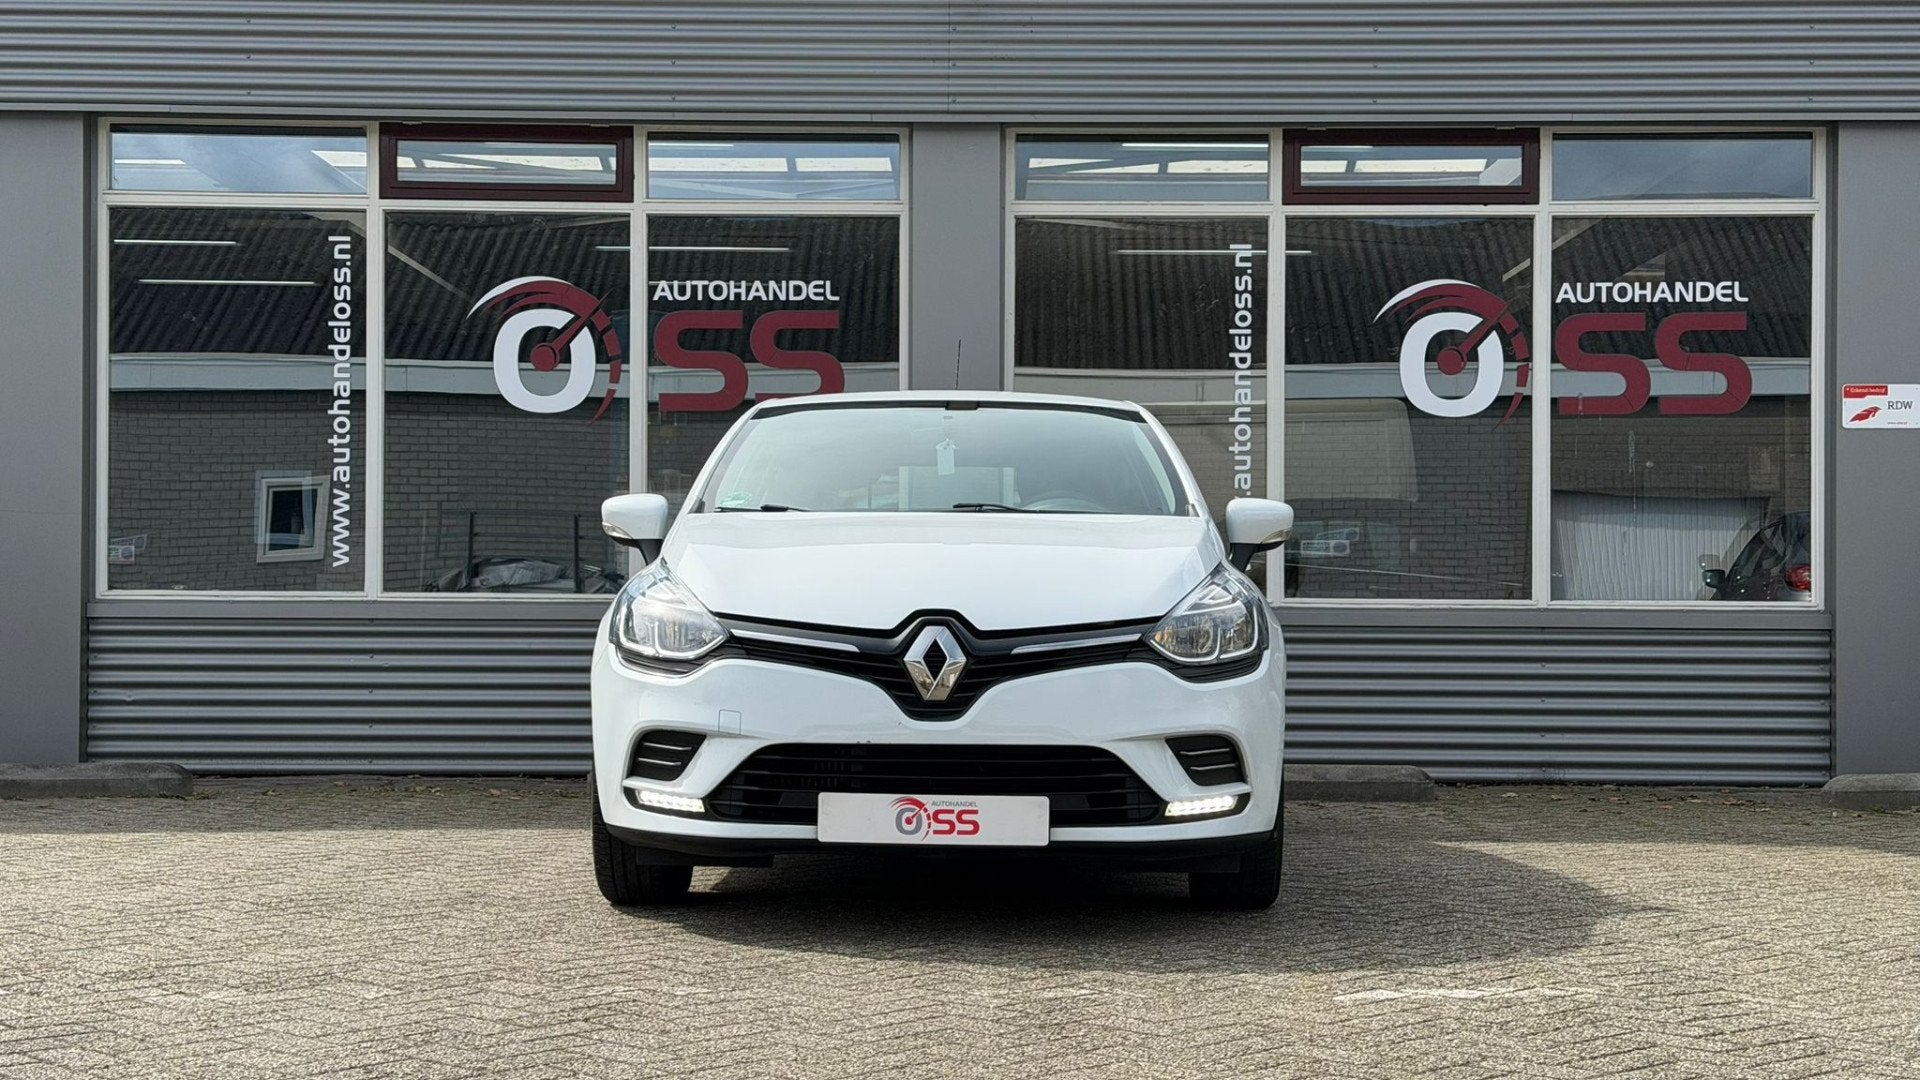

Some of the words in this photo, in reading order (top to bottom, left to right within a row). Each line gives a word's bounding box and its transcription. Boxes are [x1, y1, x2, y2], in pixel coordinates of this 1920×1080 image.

[652, 279, 840, 301] AUTOHANDEL
[1555, 281, 1749, 303] AUTOHANDEL
[493, 308, 845, 413] OSS
[1229, 243, 1252, 500] .autohandeloss.nl
[1399, 311, 1753, 417] OSS
[327, 235, 351, 568] www.autohandeloss.nl
[1887, 400, 1913, 410] RDW
[895, 807, 980, 836] OSS
